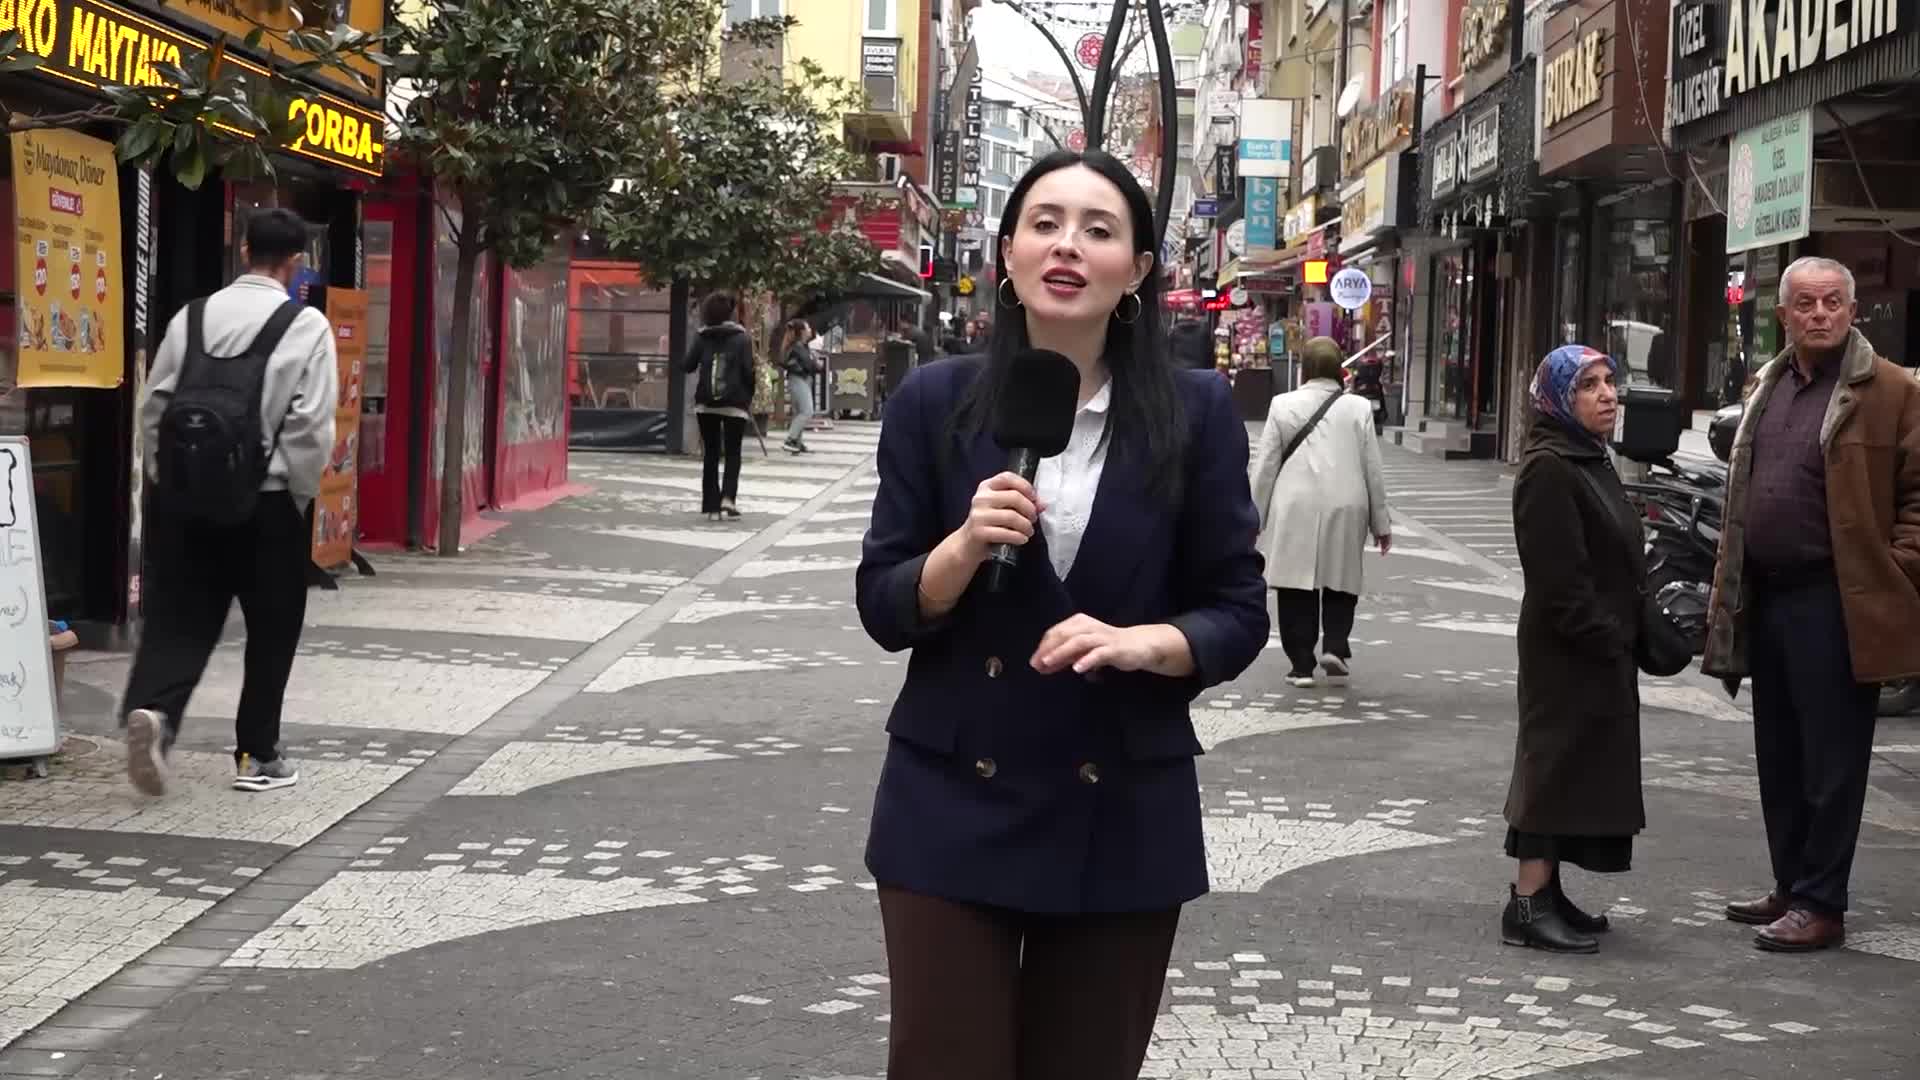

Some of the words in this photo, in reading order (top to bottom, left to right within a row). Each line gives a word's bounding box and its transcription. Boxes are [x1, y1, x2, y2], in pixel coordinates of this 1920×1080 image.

[1679, 2, 1706, 58] ÖZEL
[1724, 0, 1897, 98] AKADE
[1544, 30, 1601, 129] BURAK
[135, 250, 149, 336] XLARGE
